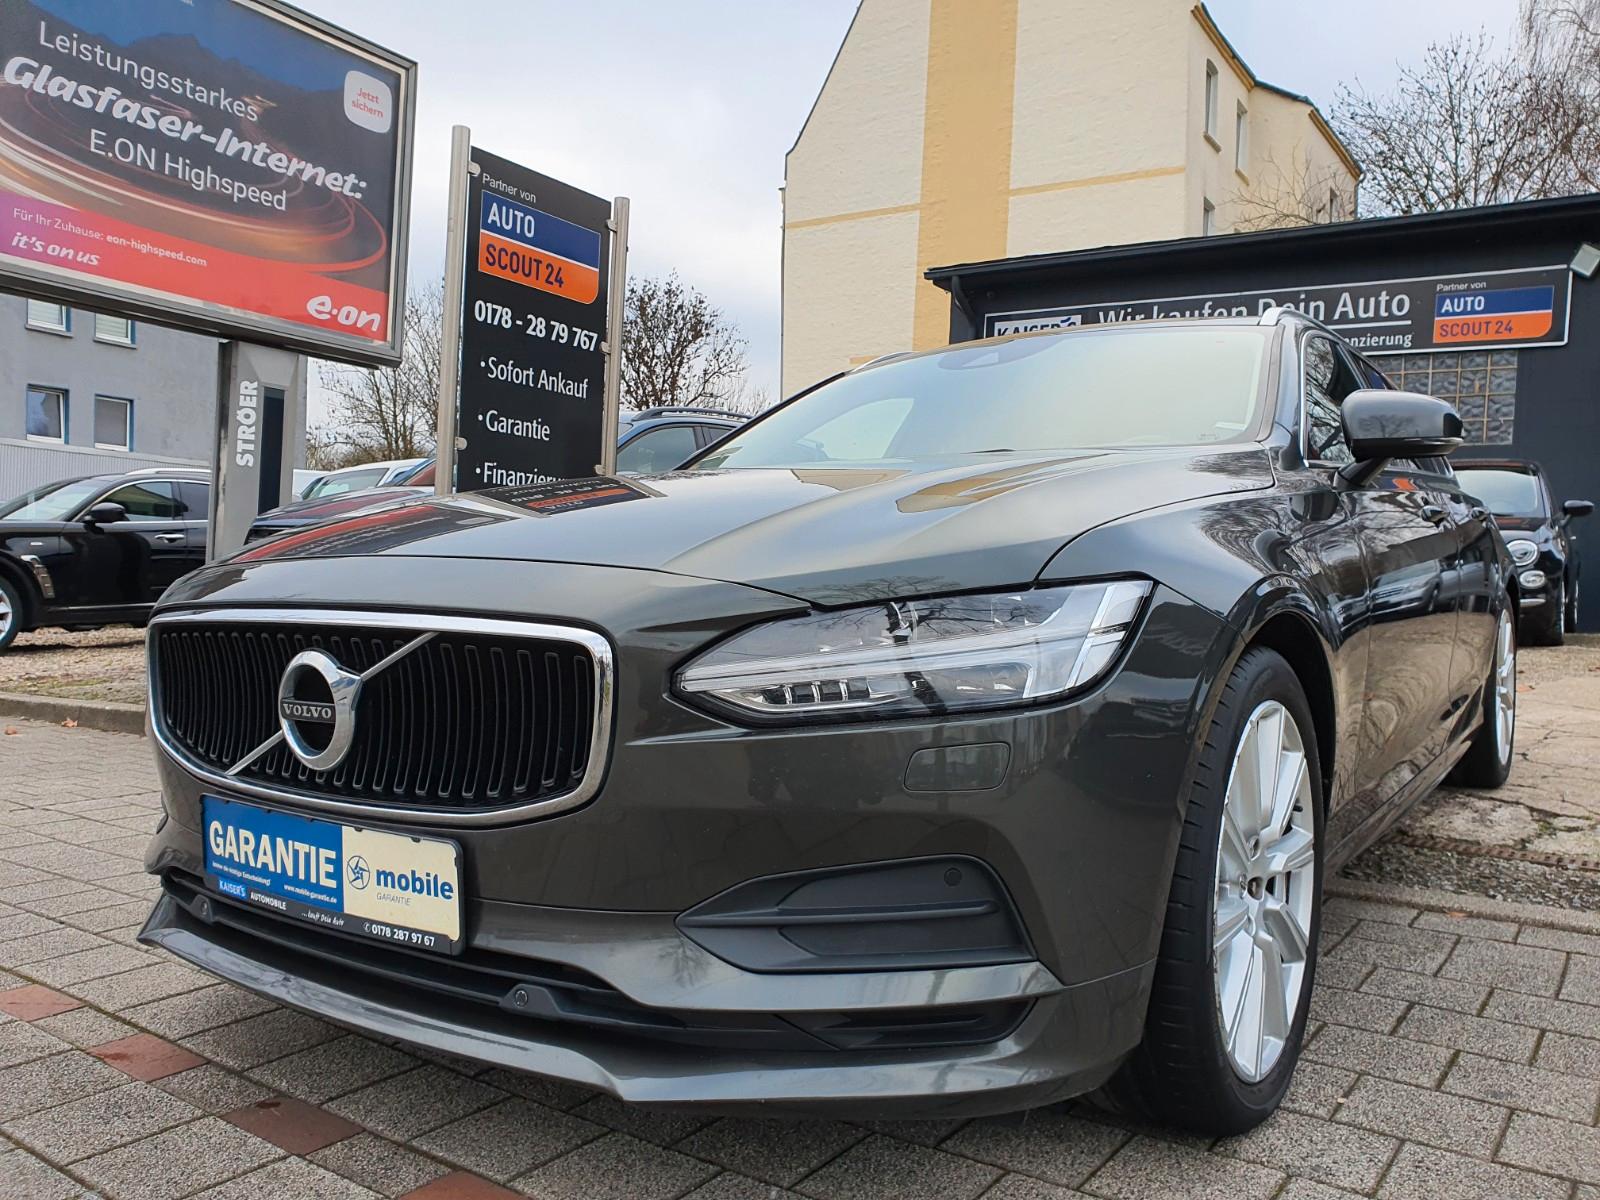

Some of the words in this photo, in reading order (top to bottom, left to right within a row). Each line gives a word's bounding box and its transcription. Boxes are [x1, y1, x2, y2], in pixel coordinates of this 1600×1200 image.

[39, 20, 259, 122] Leistungsstarkes
[351, 98, 384, 118] sichern
[356, 87, 380, 104] Jetzt
[3, 55, 368, 200] Glasfaser-Internet:
[90, 128, 156, 171] E.ON
[164, 152, 287, 212] Highspeed
[482, 172, 518, 196] Partner
[519, 189, 537, 204] von
[487, 201, 536, 239] AUTO
[13, 207, 34, 222] Für
[35, 213, 52, 227] Ihr
[54, 218, 104, 241] Zuhause:
[106, 234, 208, 267] eon-highspeed.com
[46, 243, 74, 260] on
[76, 251, 101, 267] us
[485, 243, 543, 281] SCOUT
[544, 261, 565, 289] 24
[1436, 281, 1469, 293] Partner
[1470, 280, 1487, 290] von
[1333, 290, 1411, 320] Auto
[1441, 295, 1486, 314] AUTO
[474, 299, 512, 329] 0178
[525, 313, 547, 338] 28
[550, 320, 569, 344] 79
[572, 326, 599, 352] 767
[1439, 321, 1491, 338] SCOUT
[1495, 319, 1514, 335] 24
[487, 356, 535, 388] Sofort
[537, 368, 589, 400] Ankauf
[235, 379, 259, 468] STRÖER
[485, 409, 551, 441] Garantie
[282, 702, 332, 719] VOLVO
[208, 819, 338, 890] GARANTIE
[375, 868, 454, 901] mobile
[376, 891, 412, 906] GARANTIE
[249, 891, 288, 911] AUTOMOBILE
[371, 923, 392, 938] 0178
[393, 928, 409, 941] 287
[411, 932, 423, 944] 97
[423, 935, 436, 948] 67
